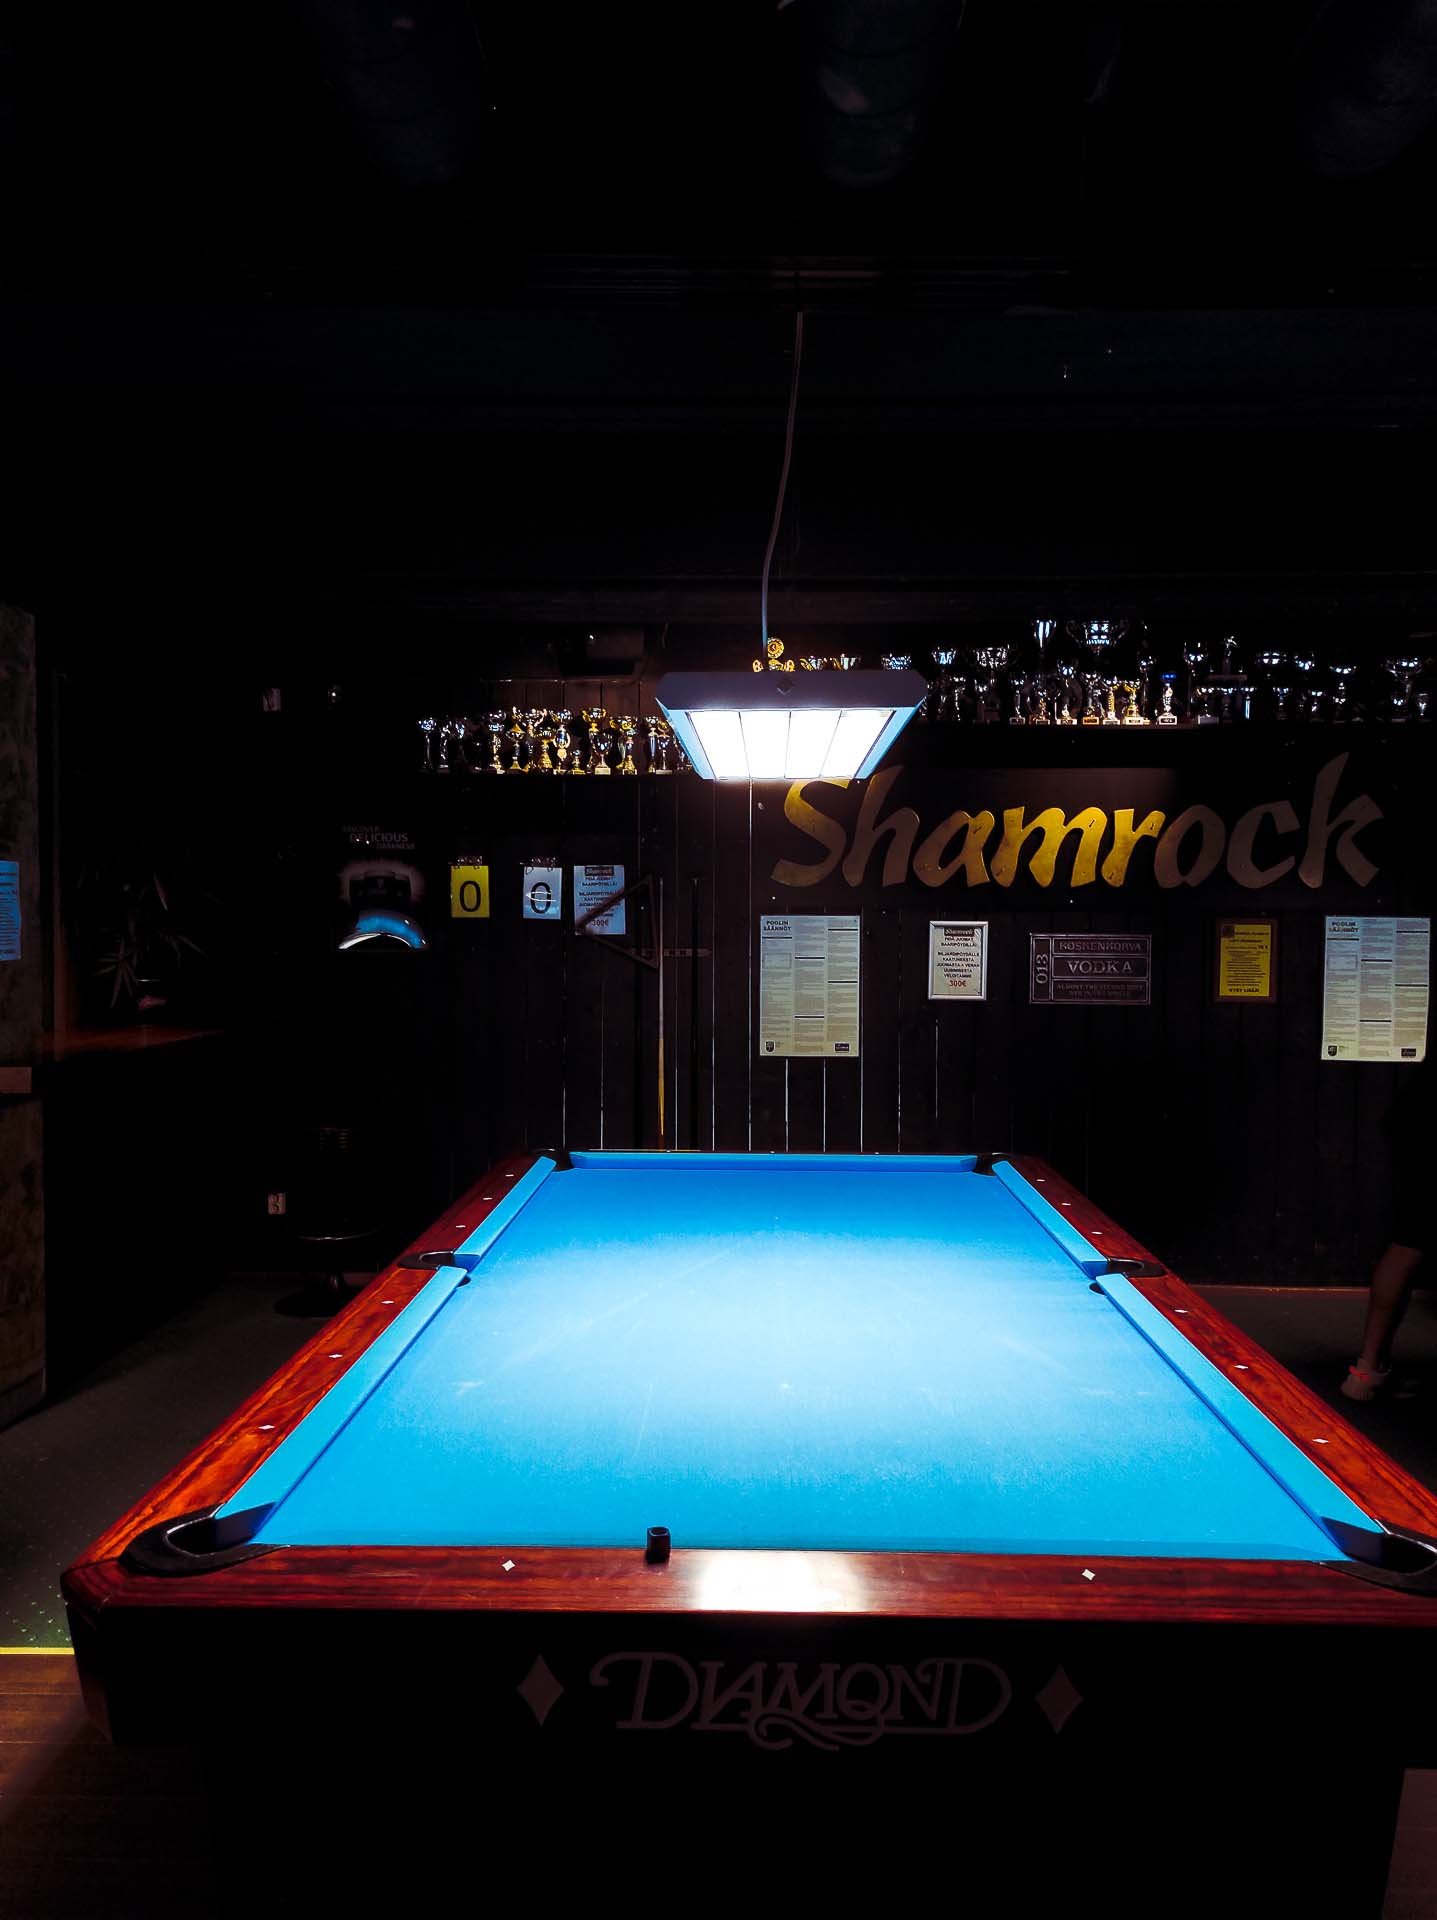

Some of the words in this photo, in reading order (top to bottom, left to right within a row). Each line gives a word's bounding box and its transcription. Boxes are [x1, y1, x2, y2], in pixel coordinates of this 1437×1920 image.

[770, 751, 1384, 889] Shamrock
[349, 832, 409, 842] DELICIOUS
[460, 880, 482, 912] 0
[529, 881, 552, 914] 0
[1059, 942, 1142, 951] KOSKENKORVA
[1035, 954, 1049, 984] 013
[1067, 960, 1132, 974] VODKA
[588, 1649, 1013, 1753] DIAMOND
